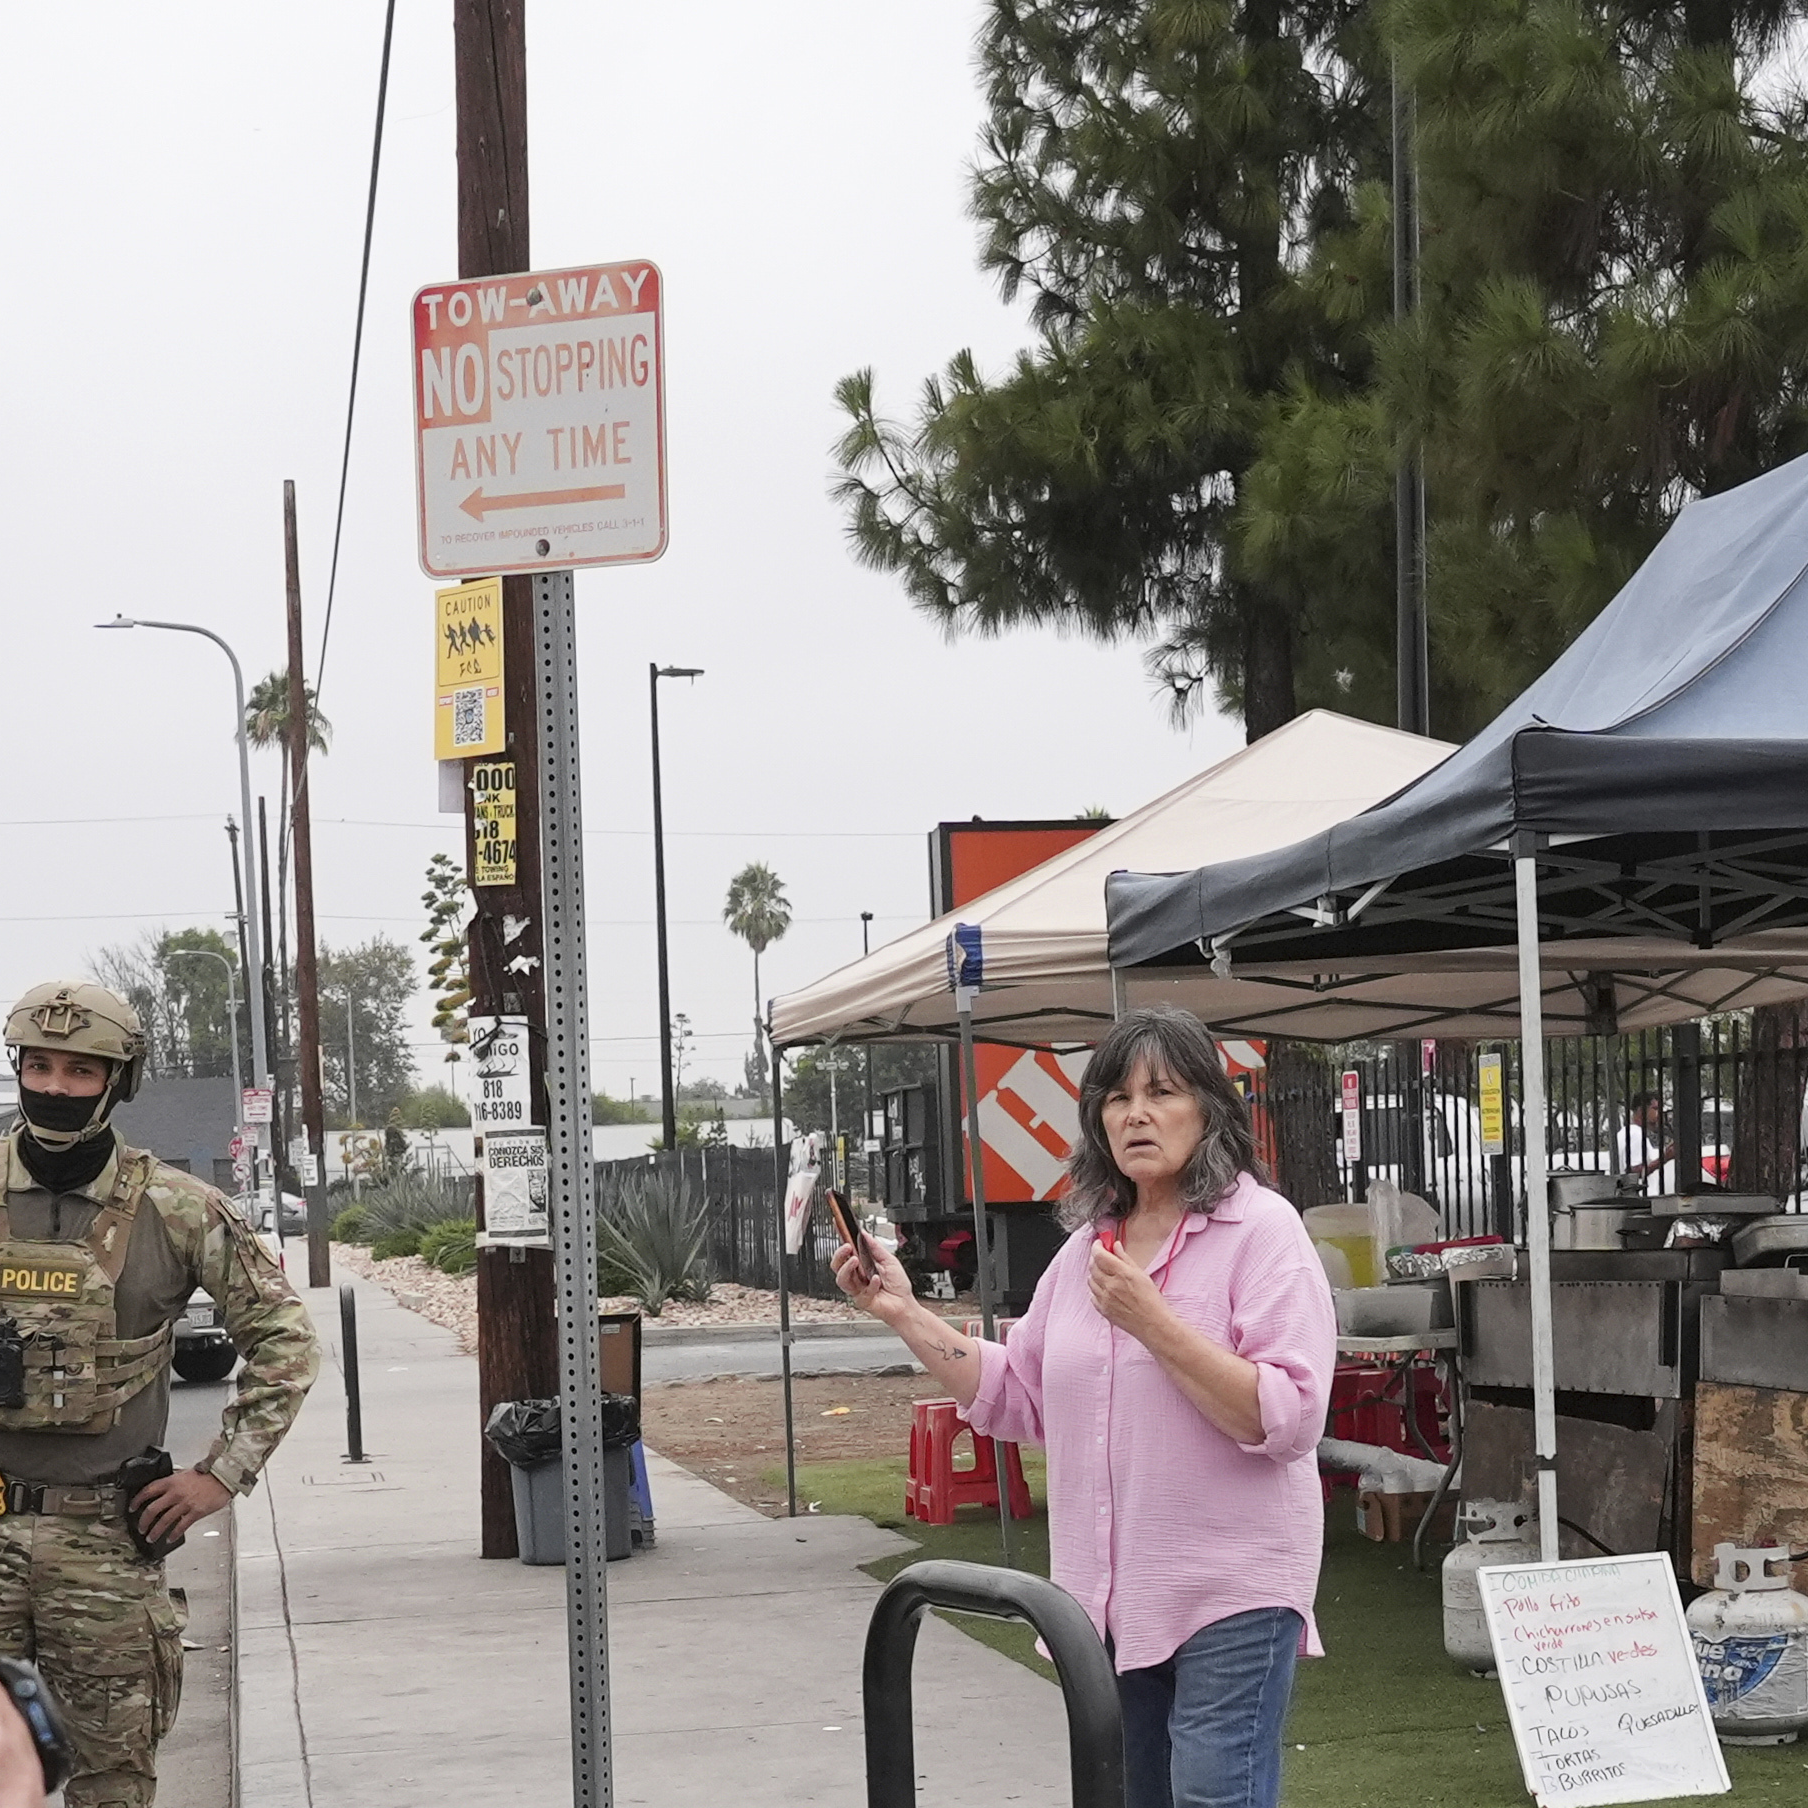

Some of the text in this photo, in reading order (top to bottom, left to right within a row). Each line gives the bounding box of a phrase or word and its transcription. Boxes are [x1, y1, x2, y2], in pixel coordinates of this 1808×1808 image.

[421, 269, 650, 331] TOW-AWAY
[421, 334, 649, 419] NO STOPPING
[450, 421, 632, 481] ANY TIME
[441, 535, 452, 544] TO
[455, 531, 496, 543] RECOVER
[499, 526, 549, 540] IMPOUNDED
[552, 522, 594, 535] VEHICLES
[597, 519, 619, 531] CALL
[445, 593, 491, 617] CAUTION
[483, 1079, 503, 1098] 818
[488, 1145, 528, 1157] CONOZCA
[489, 1155, 544, 1168] DERECHOS
[1, 1268, 78, 1293] POLICE
[1503, 1596, 1540, 1620] Pollo
[1545, 1679, 1642, 1715] PUPUSAS
[1528, 1725, 1590, 1746] TACOS
[1538, 1749, 1601, 1771] TORTAS
[1558, 1762, 1626, 1792] BURRITOS
